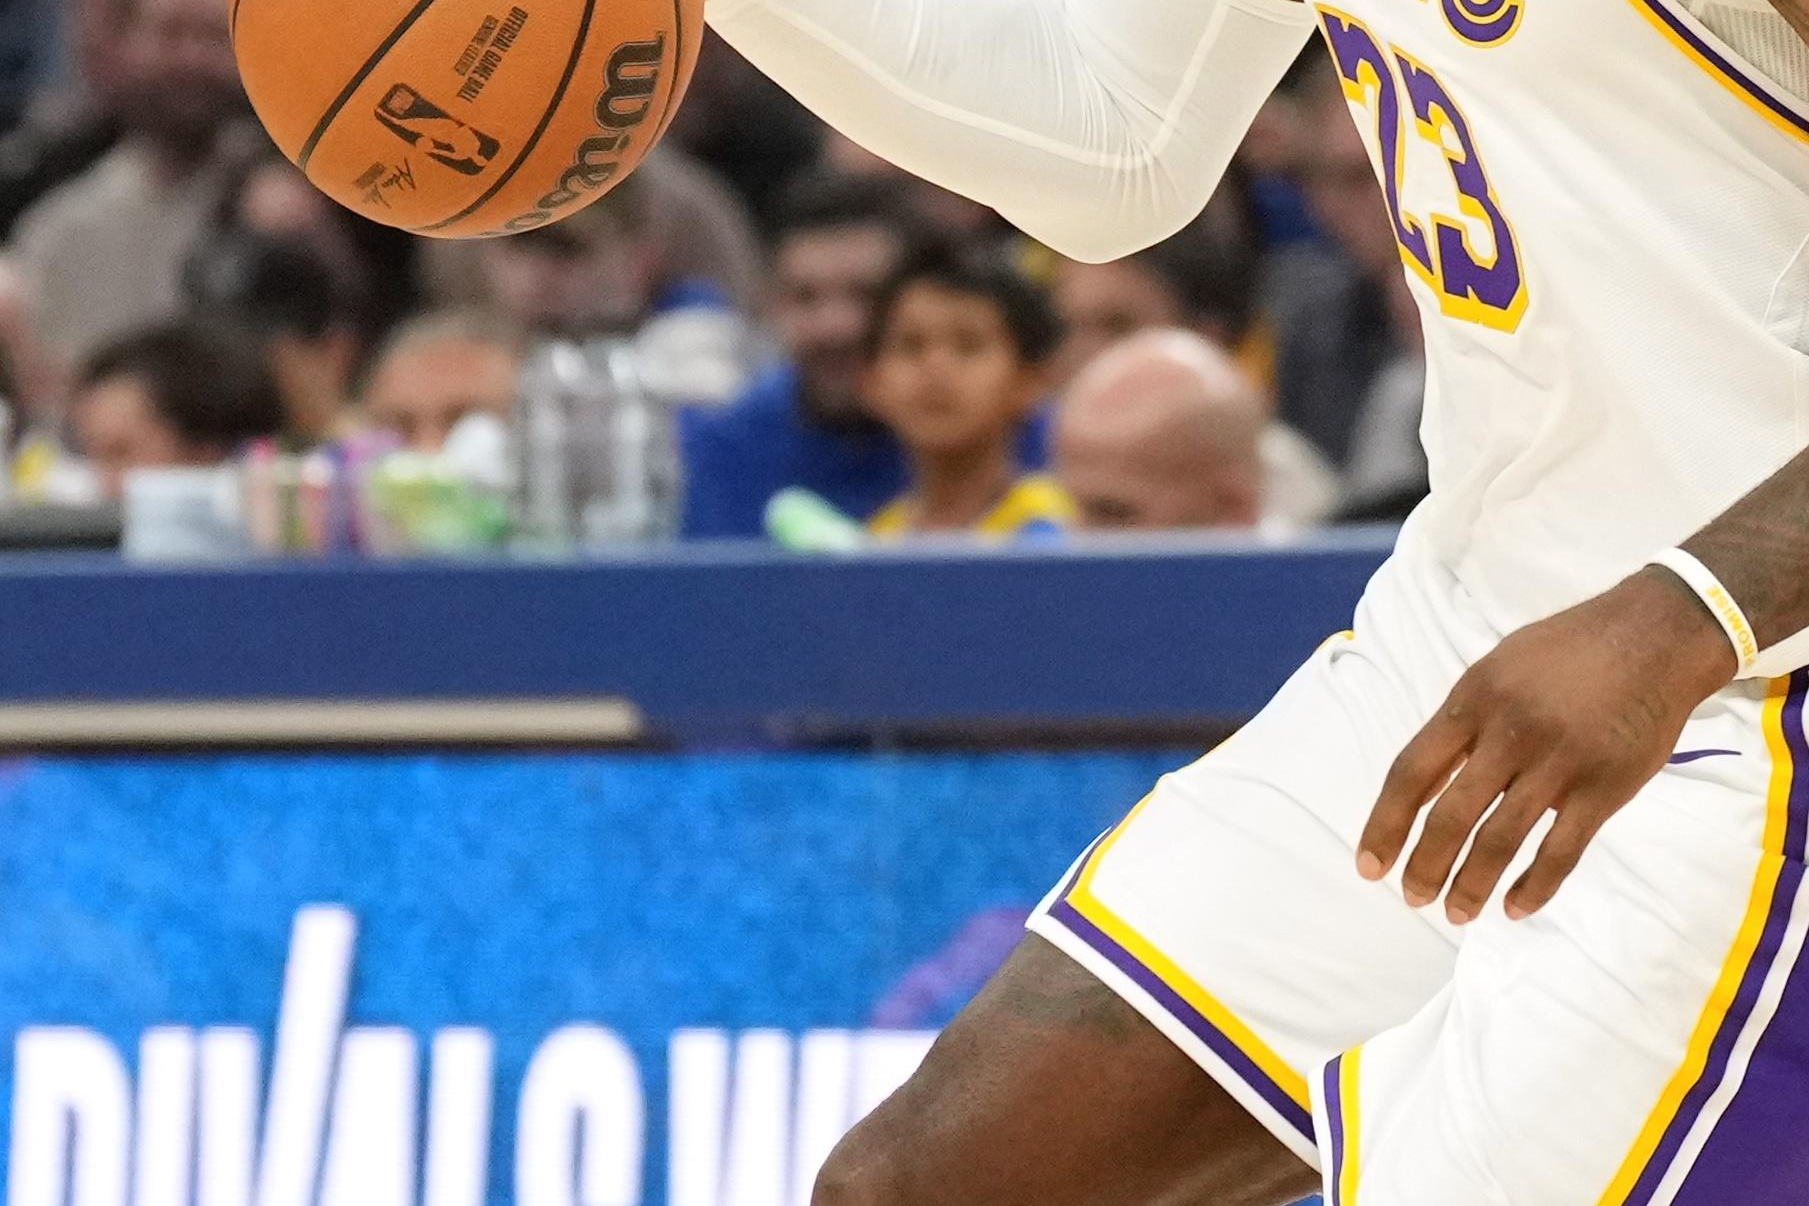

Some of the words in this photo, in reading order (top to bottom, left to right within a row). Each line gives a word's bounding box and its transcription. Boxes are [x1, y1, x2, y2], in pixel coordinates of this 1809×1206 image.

[490, 6, 528, 52] OFFICIAL
[472, 49, 502, 81] GAME
[456, 76, 484, 103] BALL
[1314, 2, 1529, 333] 23
